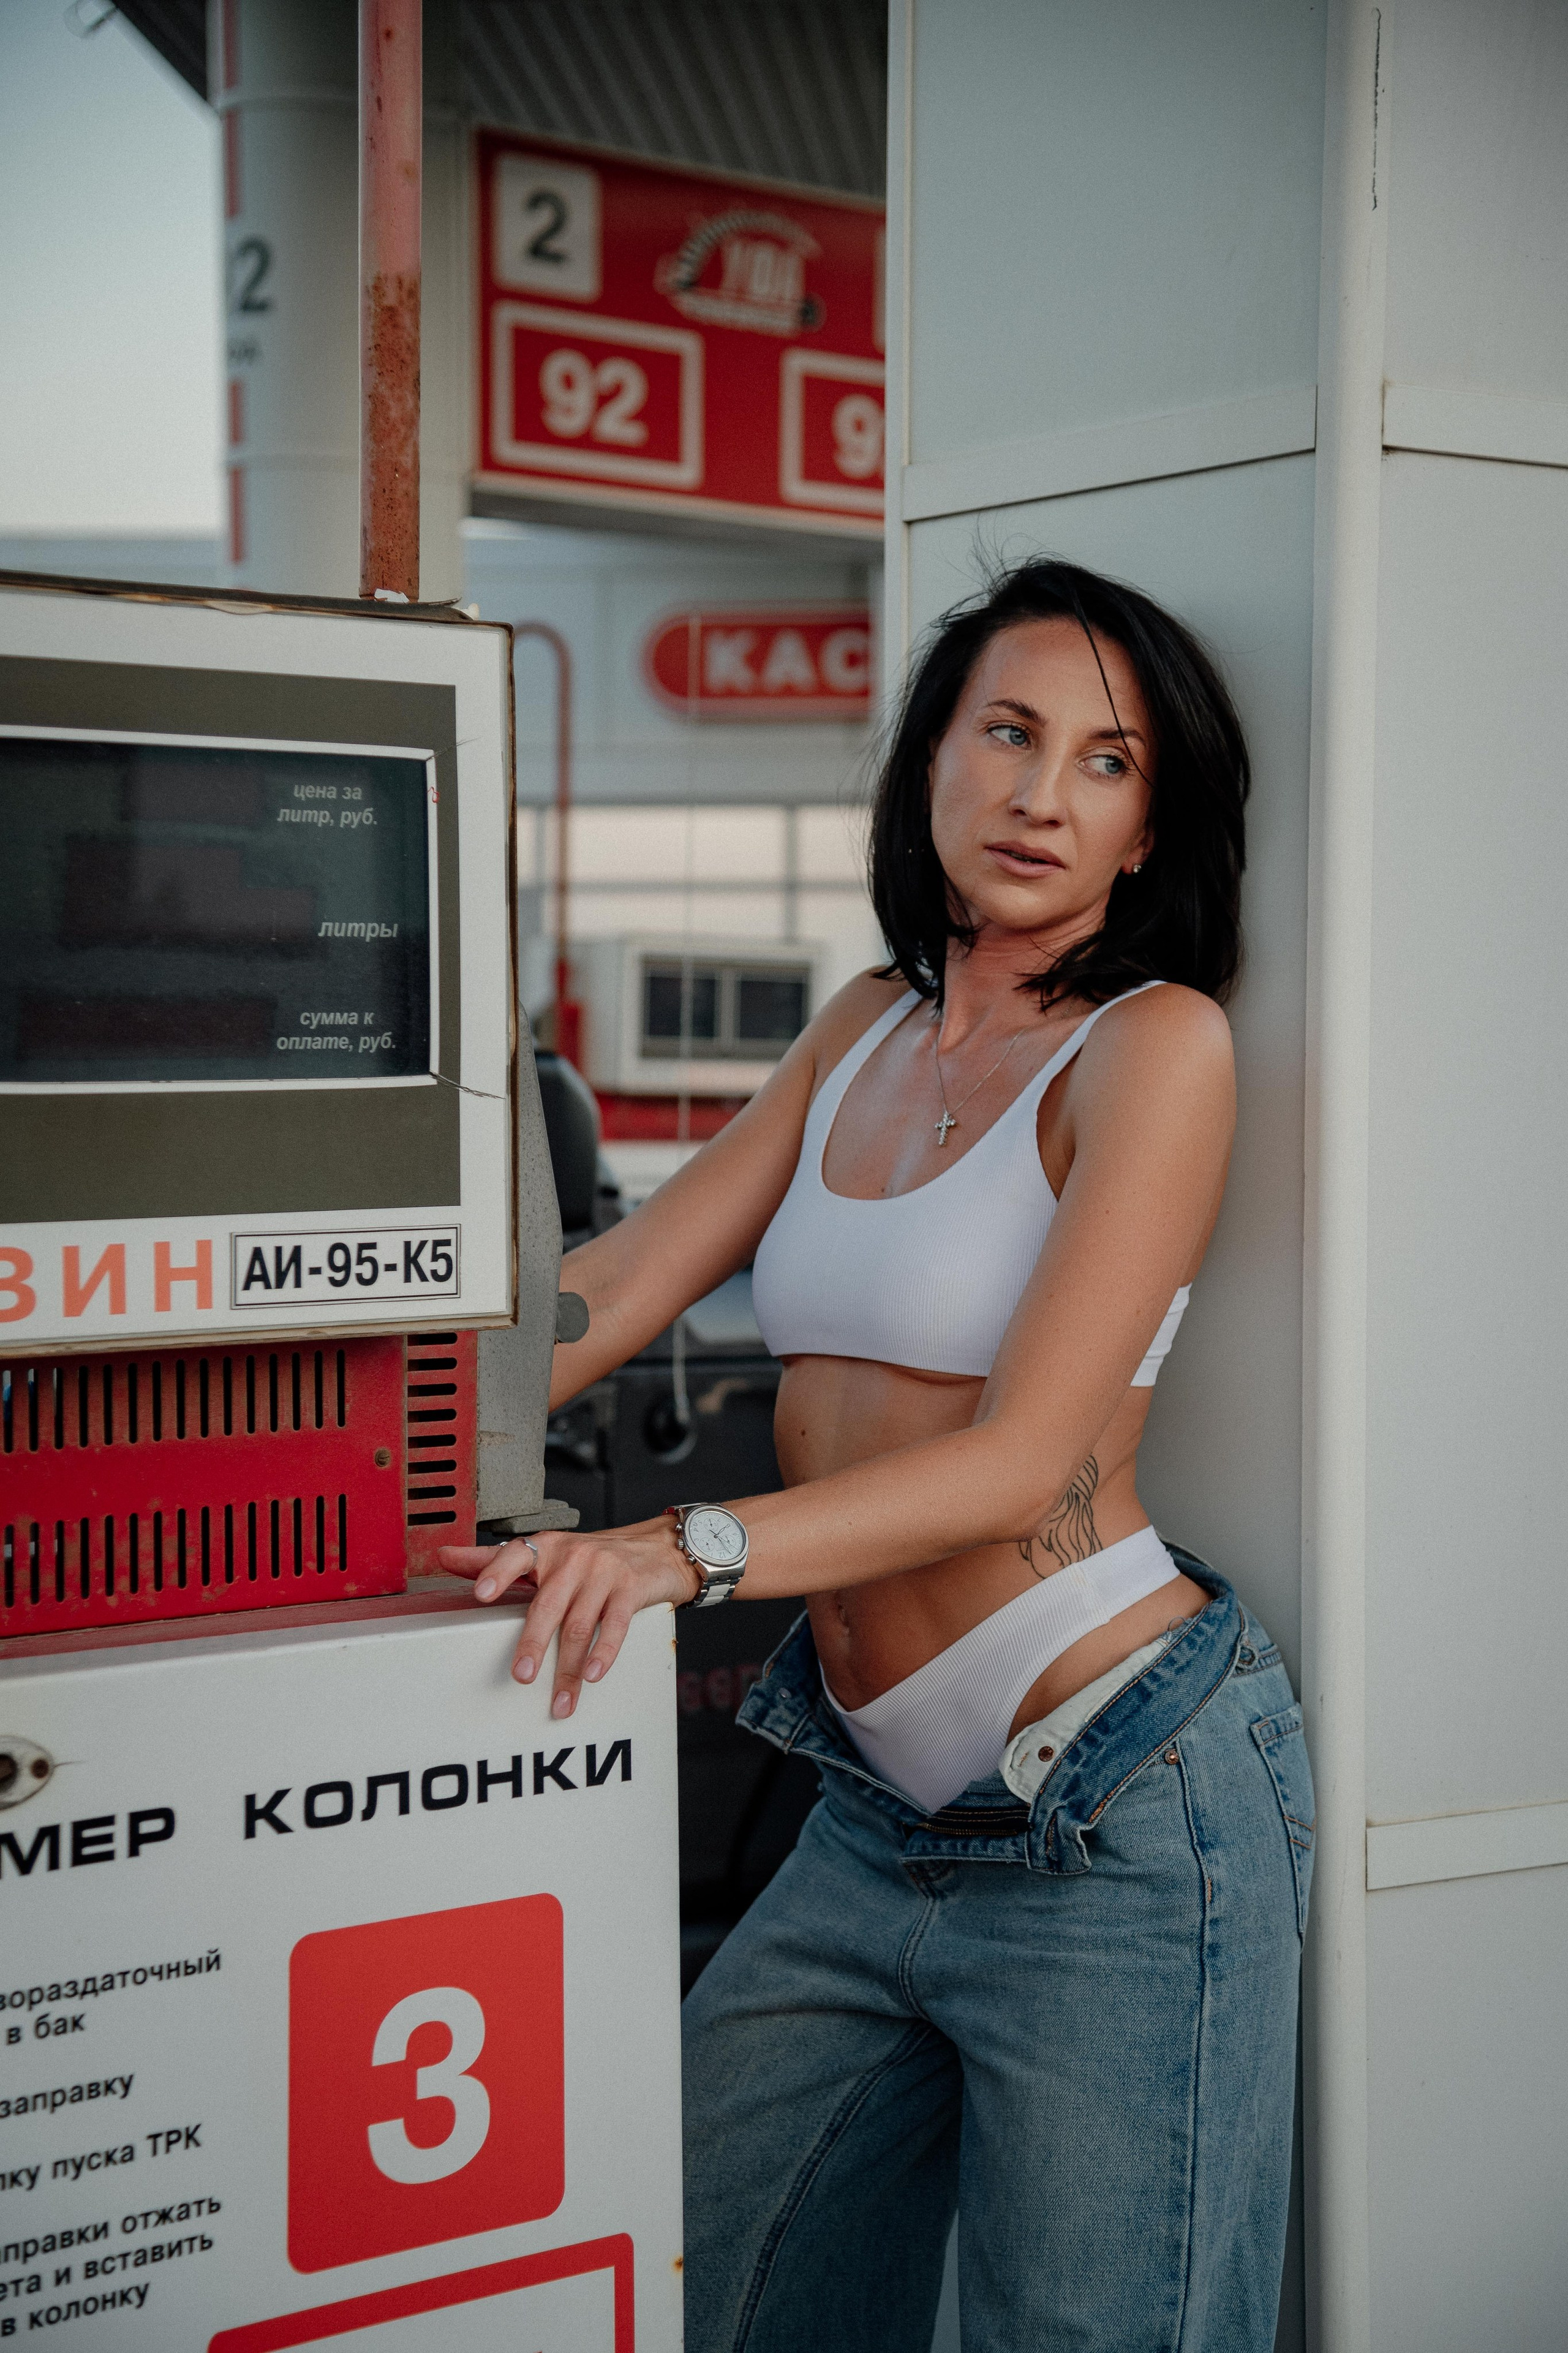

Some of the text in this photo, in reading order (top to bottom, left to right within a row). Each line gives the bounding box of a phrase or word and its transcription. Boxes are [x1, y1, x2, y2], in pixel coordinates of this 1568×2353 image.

[525, 189, 568, 265] 2
[237, 235, 274, 313] 2
[538, 349, 648, 447] 92
[832, 392, 884, 480] 9
[277, 807, 378, 828] литр, руб.
[293, 784, 363, 802] цена за
[317, 920, 398, 942] литры
[276, 1032, 397, 1054] оплате, руб.
[300, 1010, 375, 1030] сумма к
[242, 1238, 454, 1291] АИ-95-К5
[0, 1738, 633, 1879] МЕР КОЛОНКИ
[7, 2013, 85, 2045] в бак
[0, 2074, 134, 2120] заправку
[368, 1986, 491, 2185] 3
[52, 2145, 135, 2181] пуска
[146, 2123, 202, 2157] ТРК
[0, 2197, 222, 2264] правки отжать
[55, 2267, 72, 2287] и
[84, 2234, 214, 2279] вставить
[1, 2283, 149, 2337] в колонку
